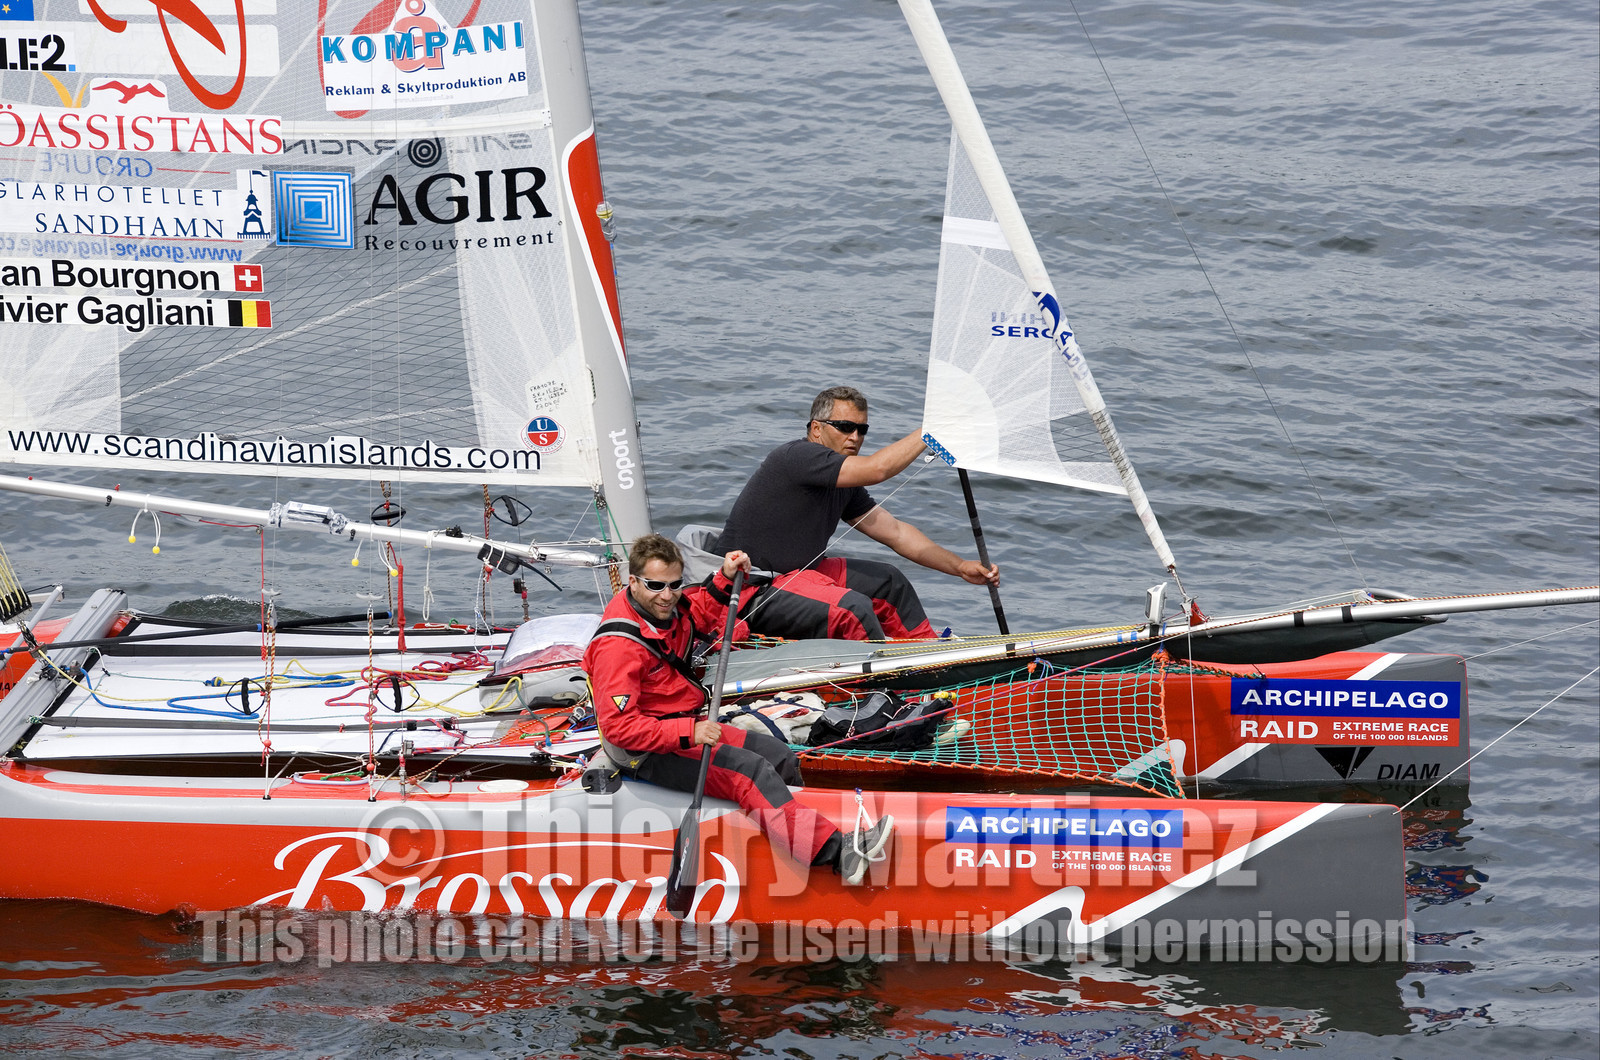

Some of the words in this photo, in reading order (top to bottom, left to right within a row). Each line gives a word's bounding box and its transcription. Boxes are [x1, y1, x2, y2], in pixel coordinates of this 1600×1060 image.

[322, 21, 525, 63] KOMPANI
[325, 84, 375, 96] Reklam
[380, 83, 392, 94] &
[397, 75, 503, 95] Skyltproduktion
[508, 71, 527, 84] AB
[363, 166, 553, 226] AGIR
[35, 212, 224, 239] SANDHAMN
[363, 230, 554, 251] Recouvrement
[52, 259, 220, 296] Bourgnon
[77, 296, 214, 332] Gagliani
[7, 430, 541, 470] www.scandinavianislands.com
[608, 428, 636, 490] sport
[1241, 689, 1449, 709] ARCHIPELAGO
[1240, 720, 1319, 739] RAID
[1333, 722, 1404, 732] EXTREME
[1408, 722, 1449, 733] RACE
[1369, 733, 1386, 741] 100
[1377, 763, 1441, 780] DIAM
[956, 816, 1172, 838] ARCHIPELAGO
[955, 848, 1037, 869] RAID
[1051, 850, 1125, 862] EXTREME
[1129, 852, 1172, 863] RACE
[1051, 862, 1065, 870] OF
[1068, 862, 1087, 870] THE
[1090, 863, 1107, 871] 100
[1109, 863, 1126, 871] 000
[1129, 864, 1172, 872] ISLANDS
